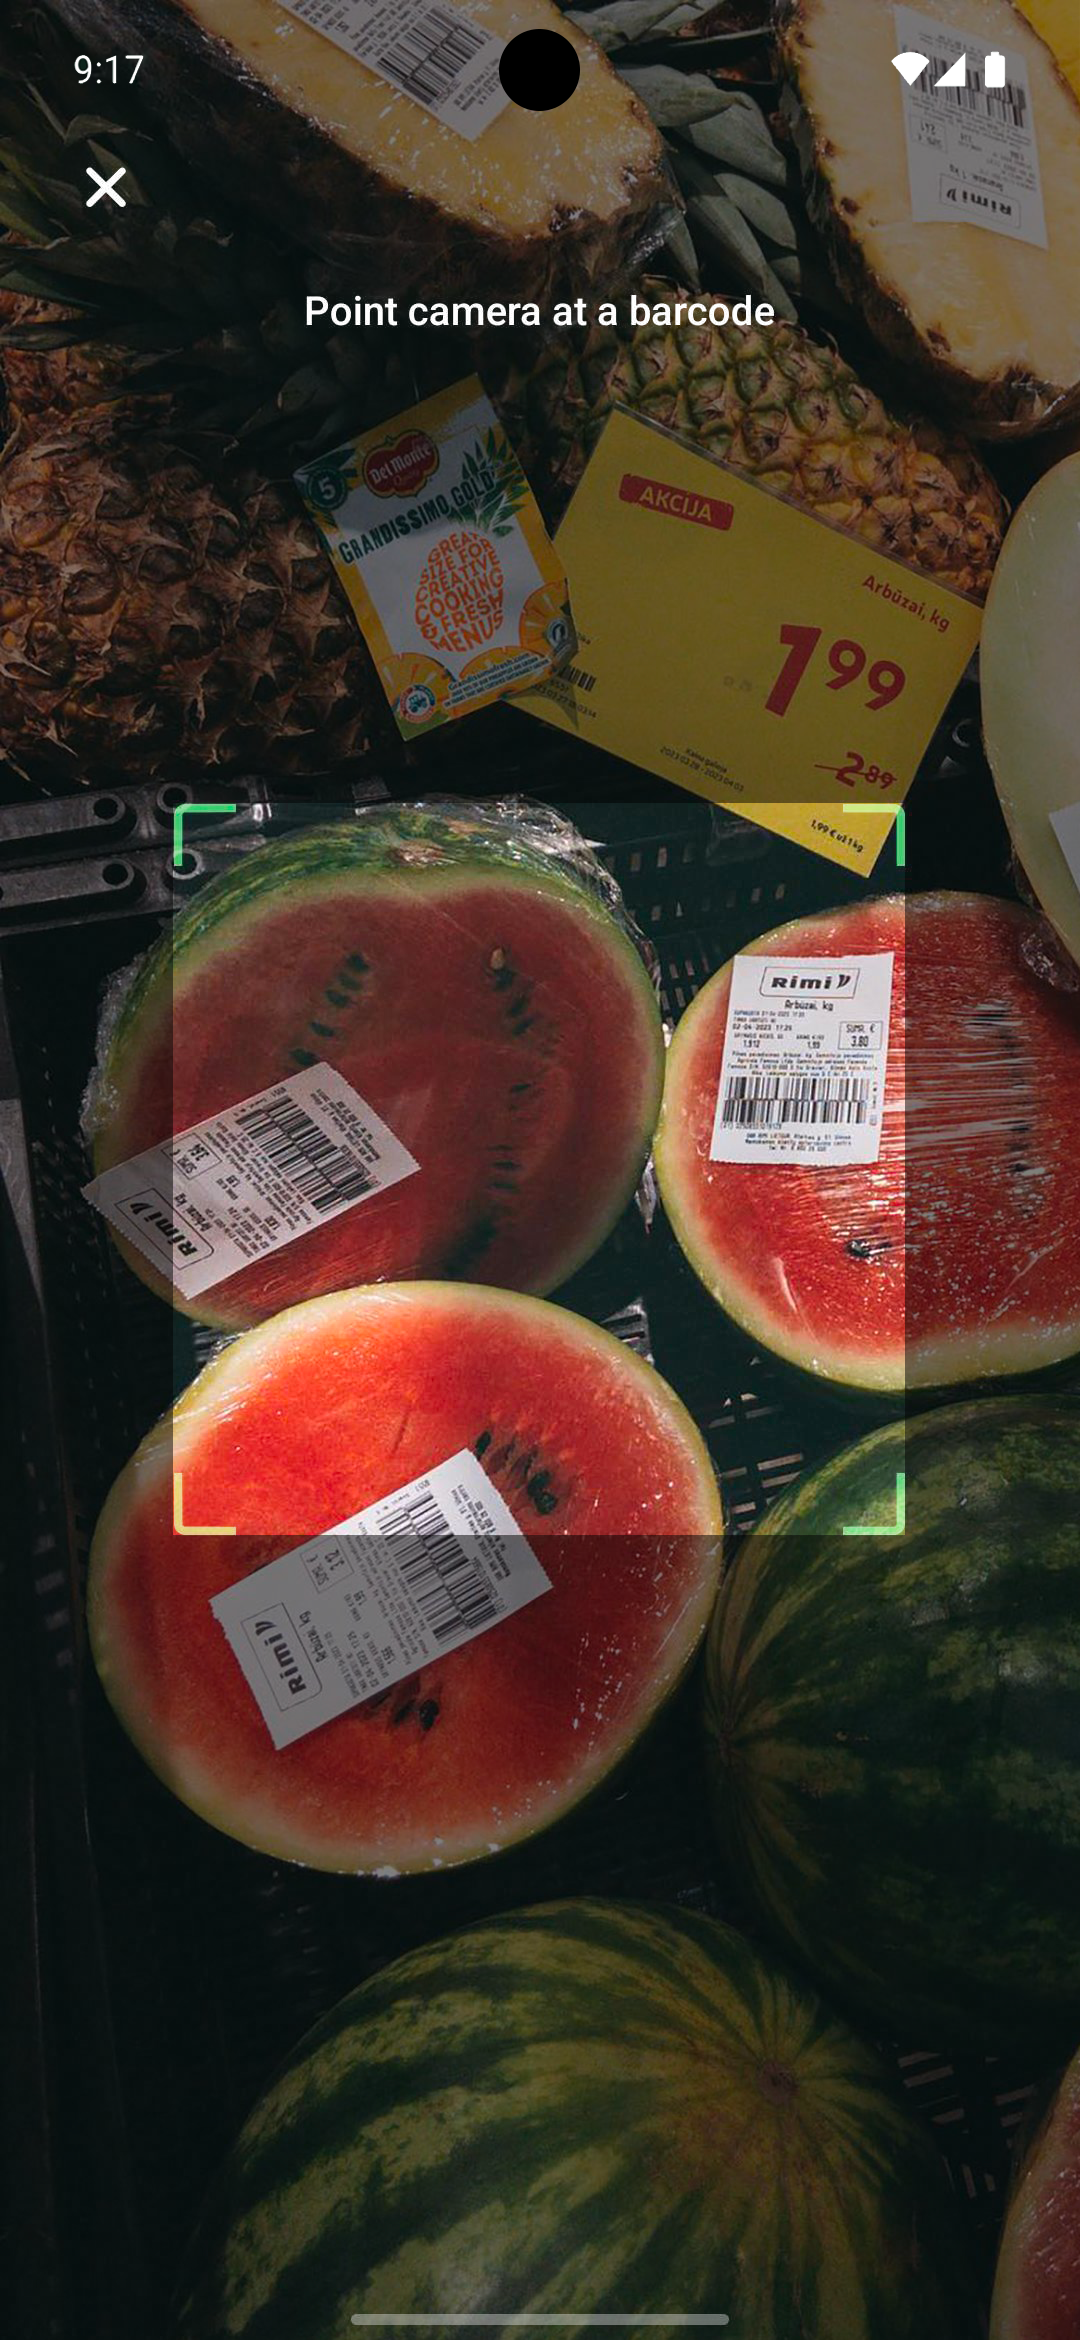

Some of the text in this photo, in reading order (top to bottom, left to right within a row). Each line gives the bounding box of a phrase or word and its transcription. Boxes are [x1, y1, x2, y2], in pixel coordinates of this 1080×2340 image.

[960, 190, 1010, 215] Rimi
[369, 463, 392, 484] Del
[389, 440, 431, 472] Monte
[318, 476, 334, 499] 5
[638, 486, 710, 521] AKCIJA
[337, 469, 495, 564] GRANDISSIMO GOLD
[415, 549, 499, 601] CREATIVE
[420, 537, 493, 584] SIZE FOR
[412, 566, 504, 625] COOKING
[440, 588, 502, 630] FRESH
[861, 574, 950, 633] Arbūzai, kg
[430, 609, 501, 650] MENUS
[851, 839, 865, 853] kg
[771, 973, 832, 990] Rimi
[822, 1000, 833, 1011] kg
[851, 1035, 868, 1047] 3.80
[173, 1194, 186, 1207] kg
[143, 1211, 197, 1256] Rimi
[323, 1548, 345, 1571] 3.12
[298, 1612, 310, 1627] kg
[263, 1632, 306, 1694] Rimi
